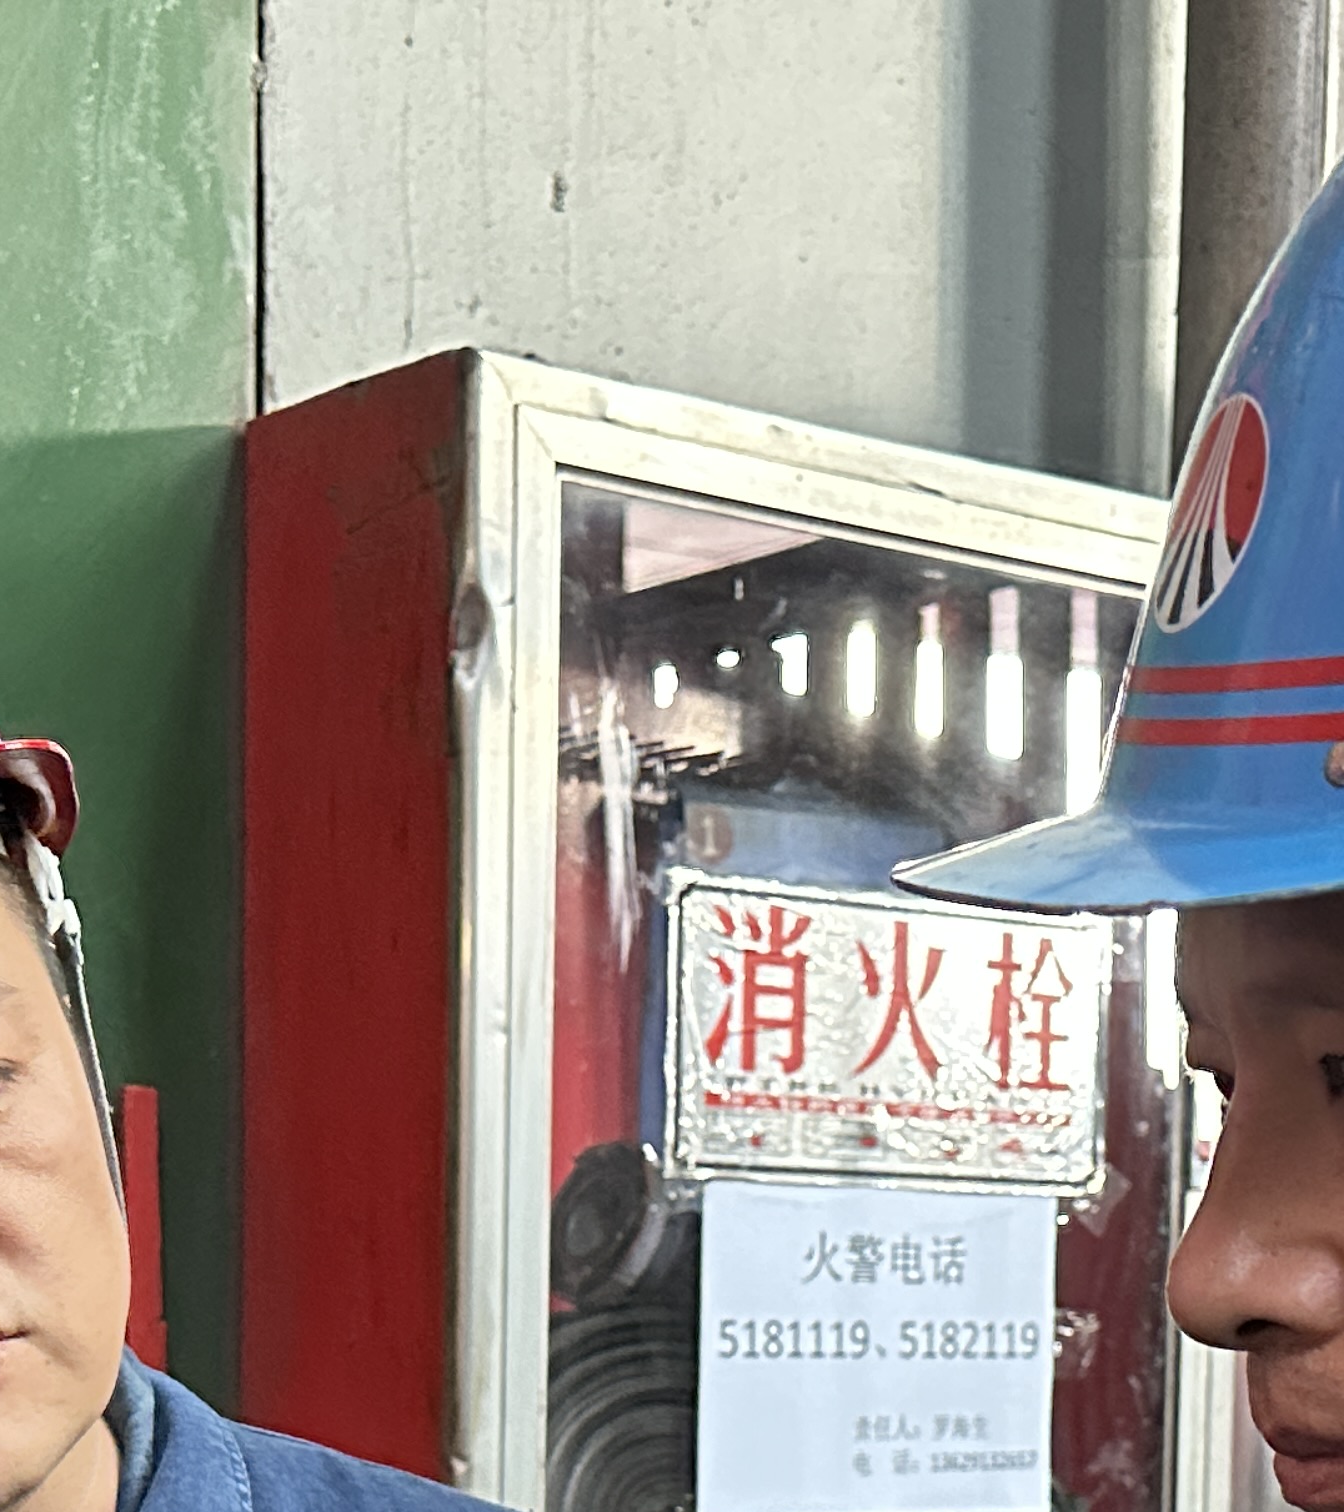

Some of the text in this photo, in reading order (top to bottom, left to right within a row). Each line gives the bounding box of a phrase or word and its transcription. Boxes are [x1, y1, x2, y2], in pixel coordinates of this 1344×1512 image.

[704, 905, 1073, 1091] 消火栓
[801, 1231, 967, 1286] 火警电话
